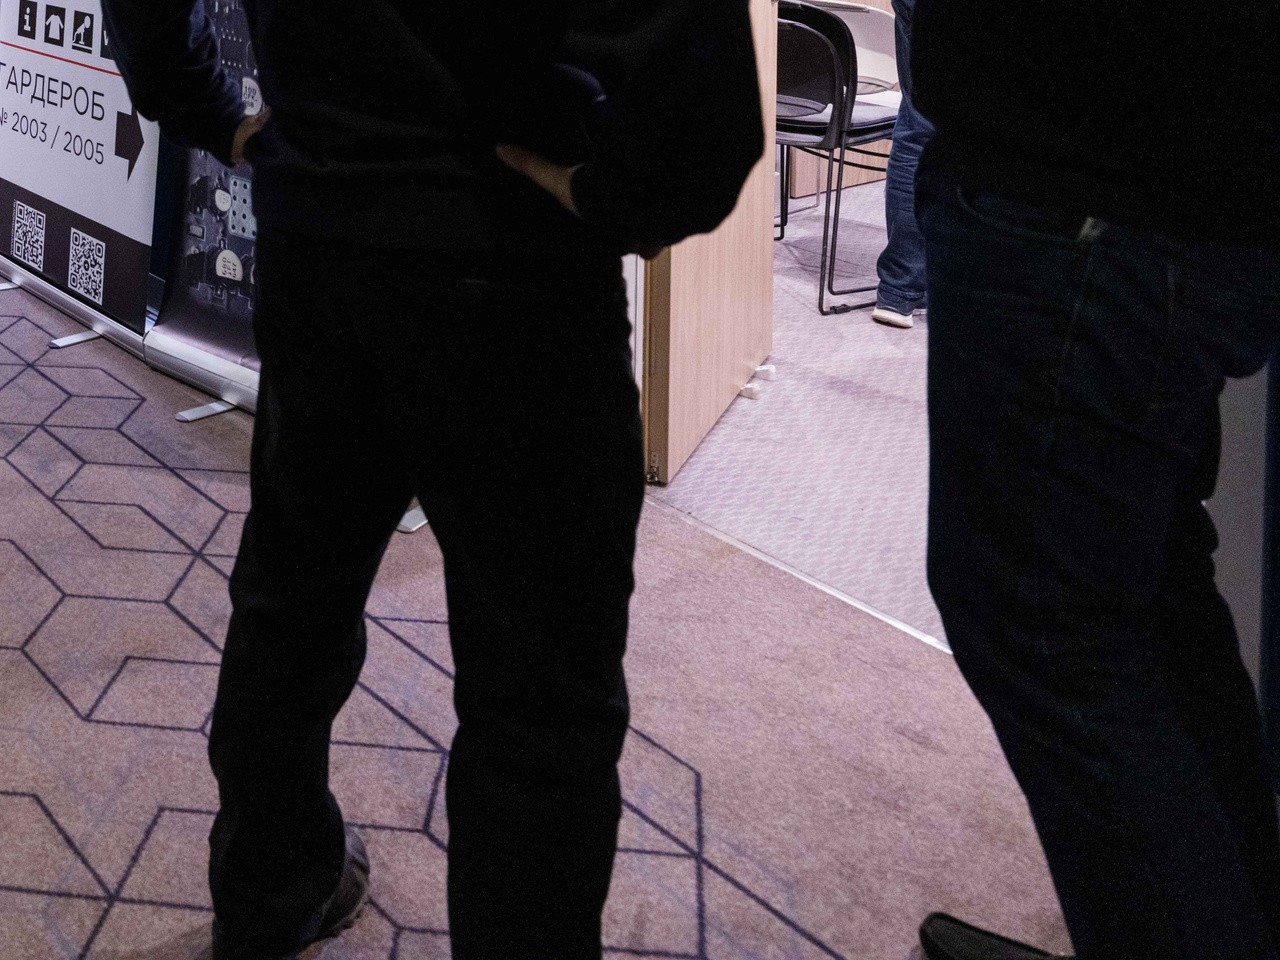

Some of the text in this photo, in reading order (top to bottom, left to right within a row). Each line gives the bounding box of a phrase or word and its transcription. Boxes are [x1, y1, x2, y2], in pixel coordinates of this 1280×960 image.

[11, 111, 48, 143] 2003
[50, 125, 61, 149] /
[63, 131, 104, 165] 2005
